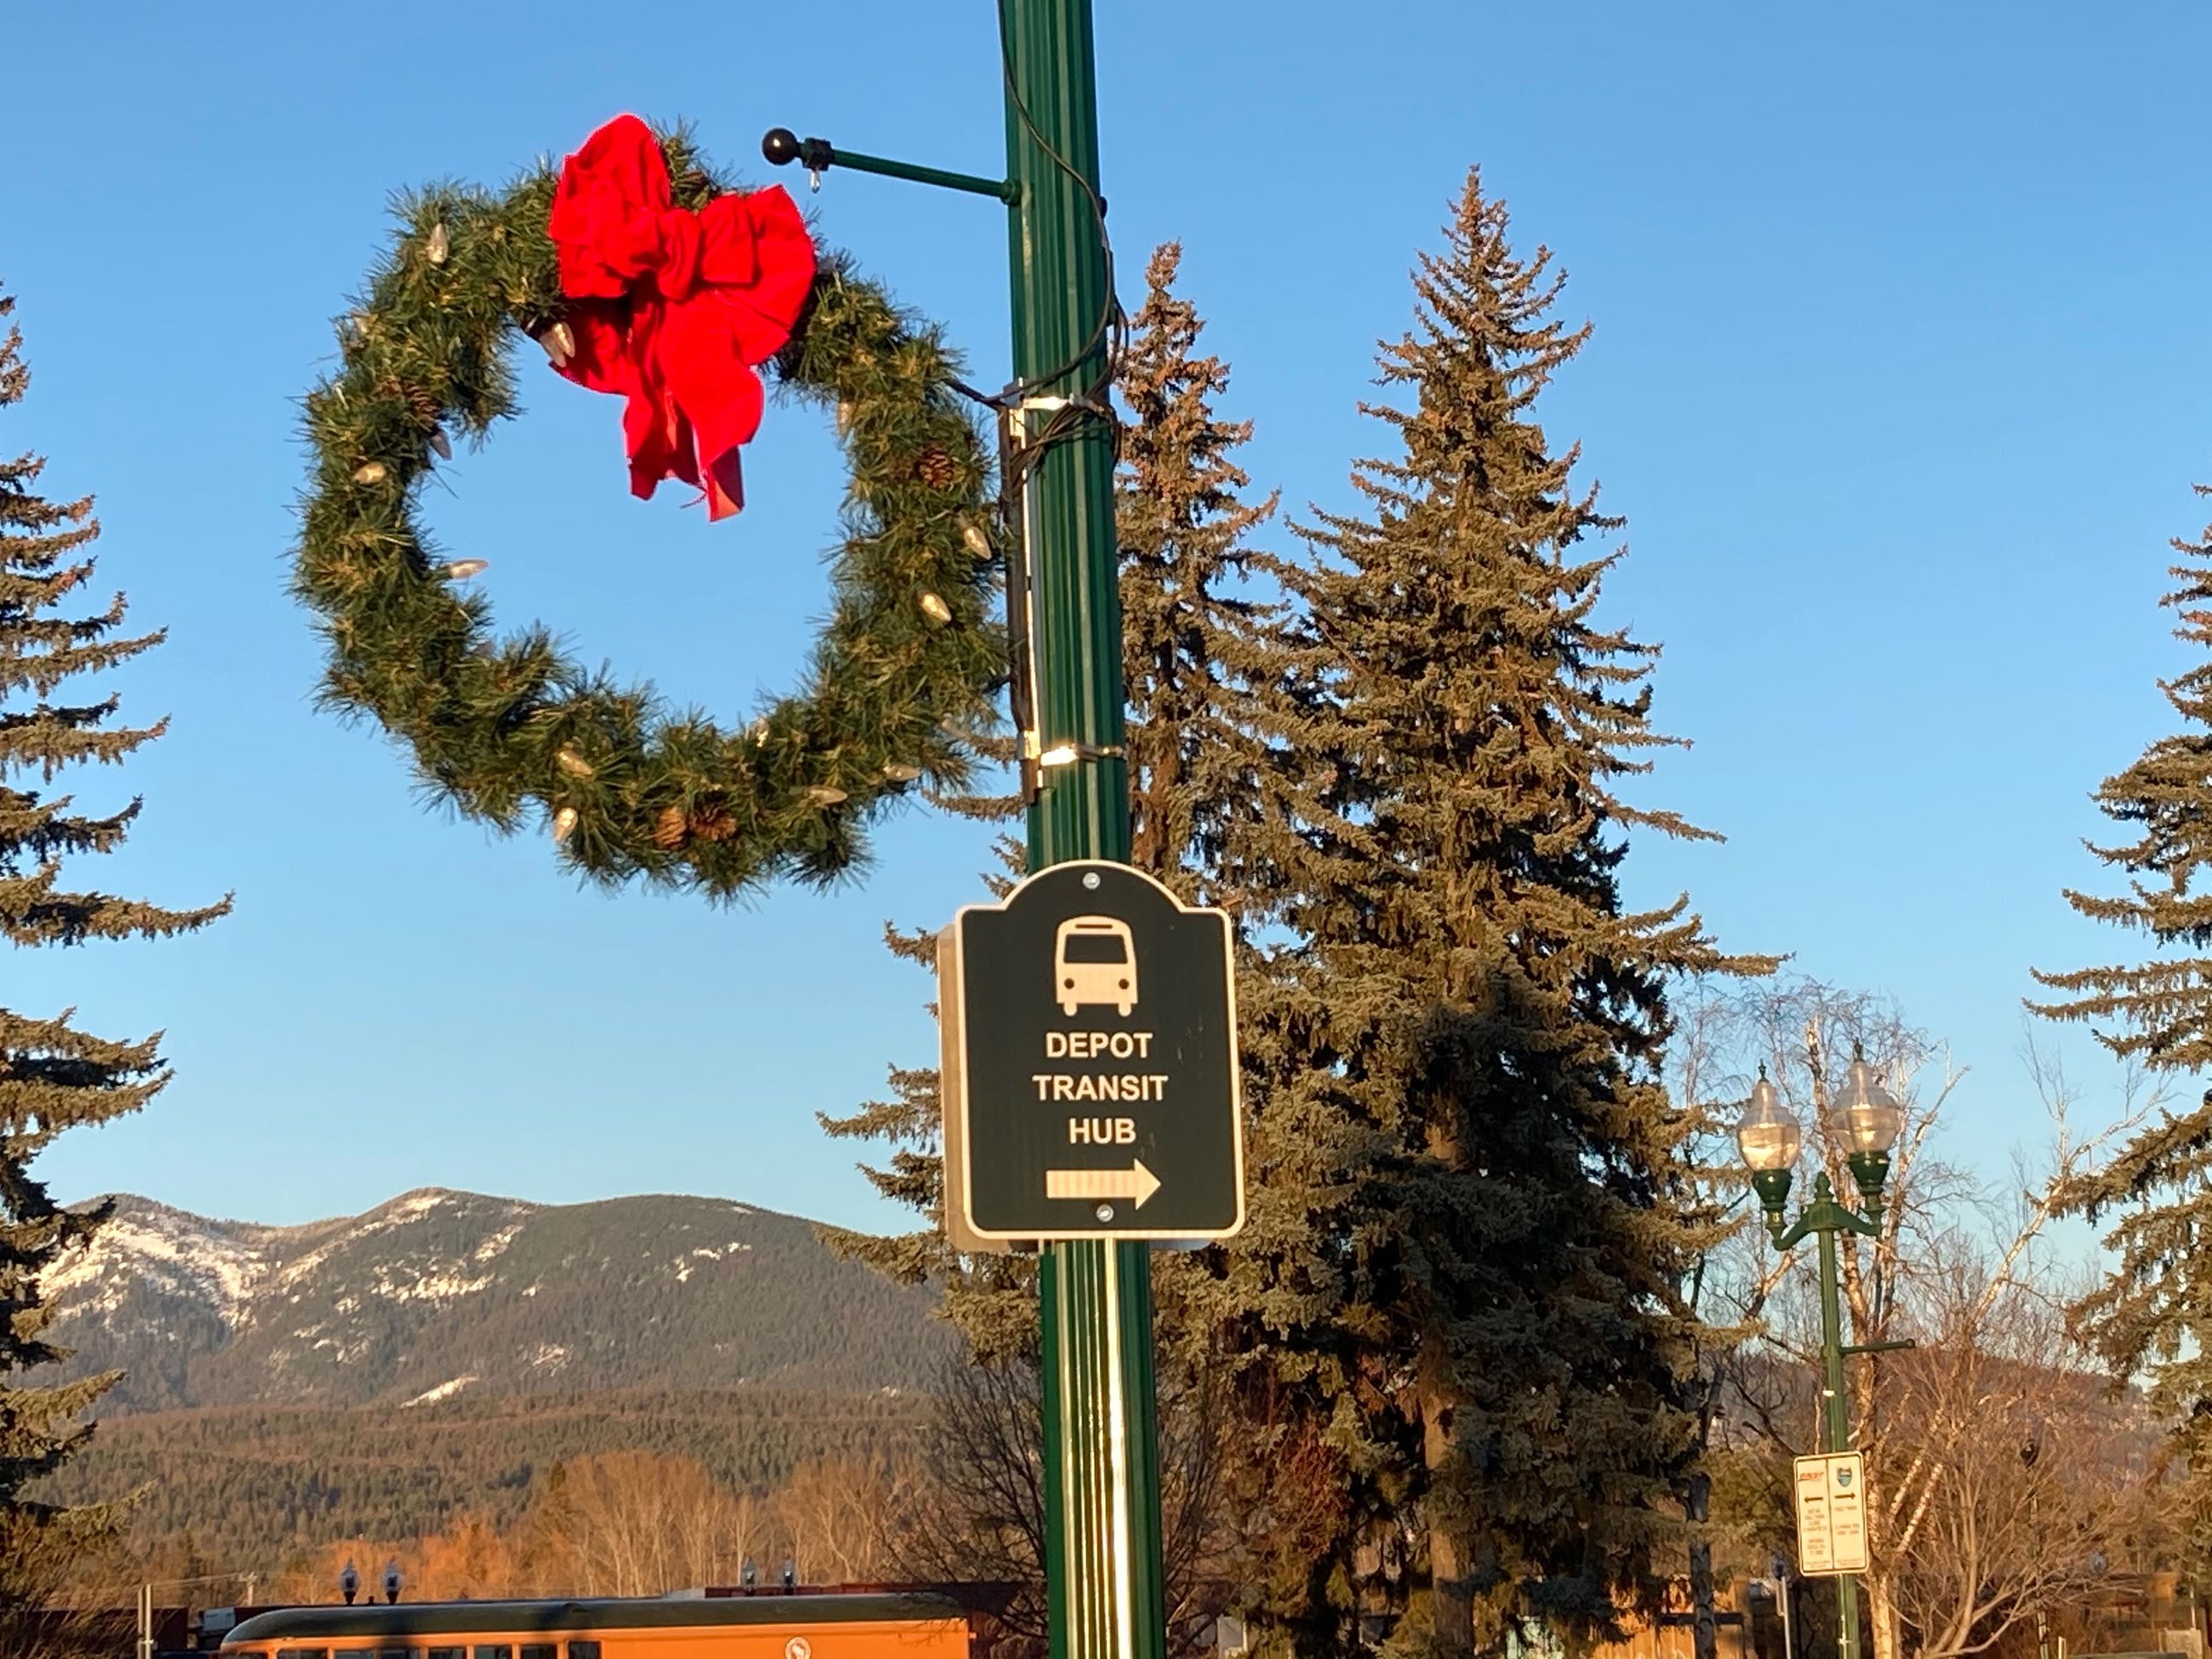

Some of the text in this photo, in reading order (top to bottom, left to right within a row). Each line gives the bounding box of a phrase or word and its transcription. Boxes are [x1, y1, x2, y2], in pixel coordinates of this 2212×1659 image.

[1046, 1032, 1154, 1058] DEPOT
[1032, 1075, 1168, 1101] TRANSIT
[1069, 1117, 1137, 1144] HUB
